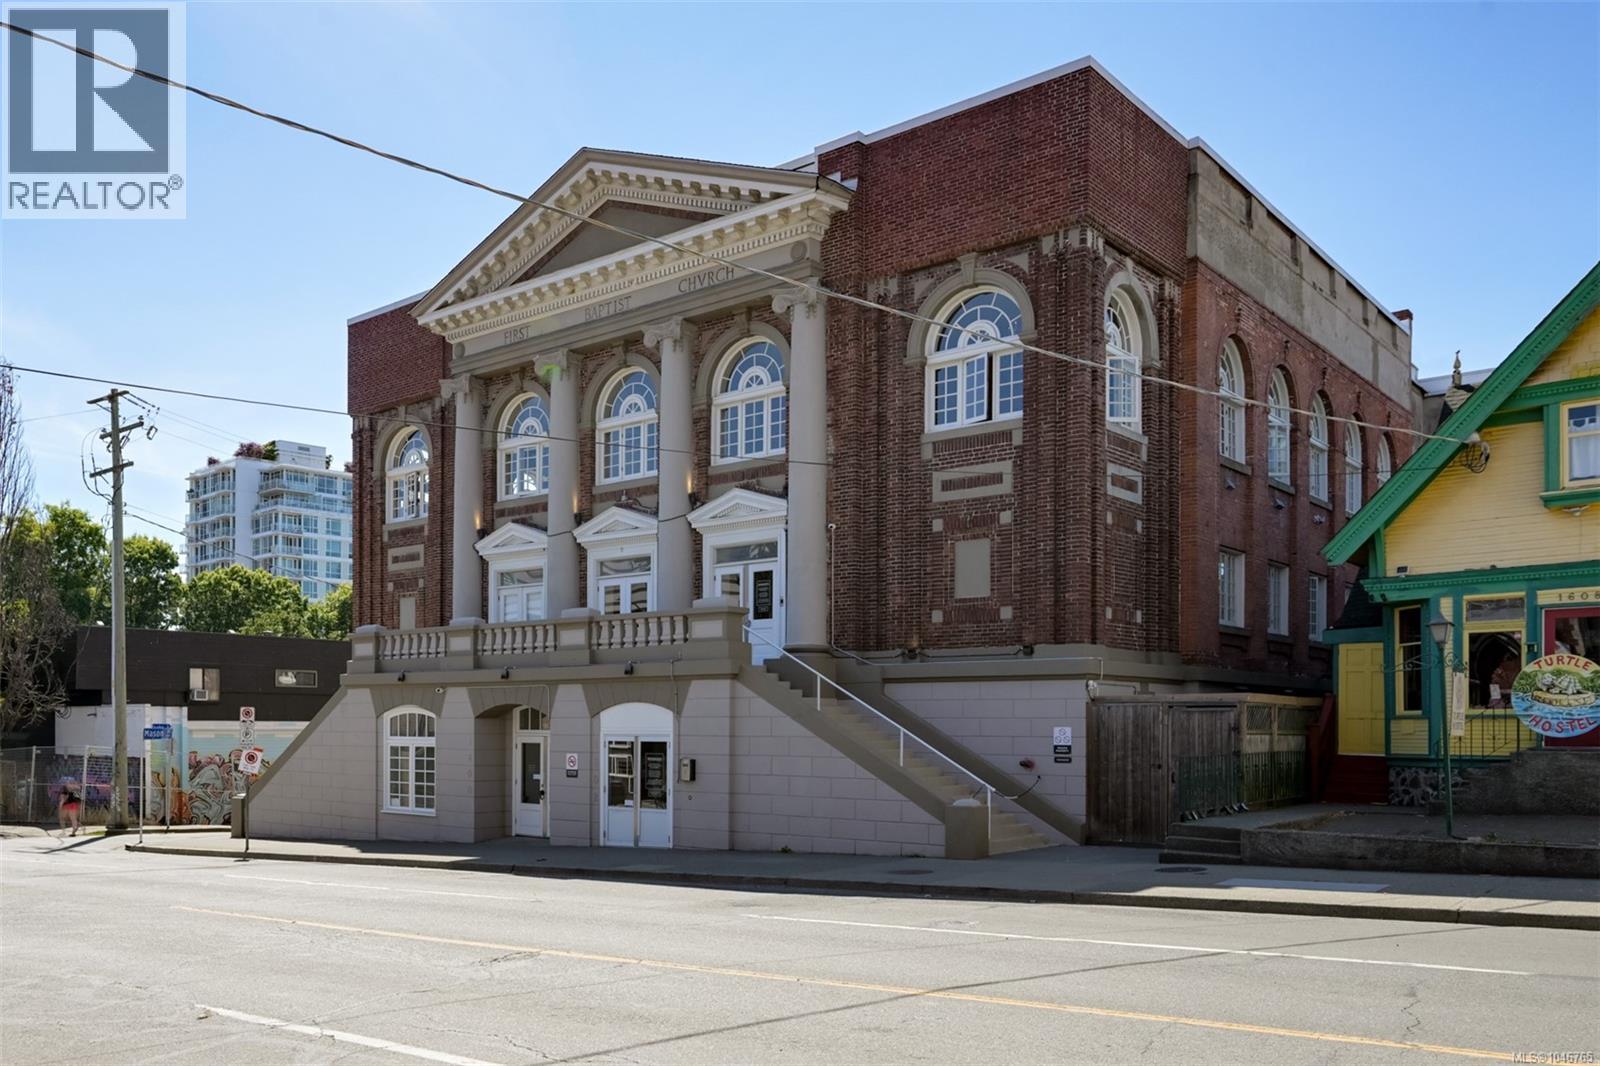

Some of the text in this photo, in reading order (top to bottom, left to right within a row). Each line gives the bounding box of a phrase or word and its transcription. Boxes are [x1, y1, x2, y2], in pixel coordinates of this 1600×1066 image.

[503, 265, 735, 345] FIRST BAPTIST CHVRCH
[1533, 655, 1593, 671] TURTLE
[1528, 714, 1598, 733] HOSTEL
